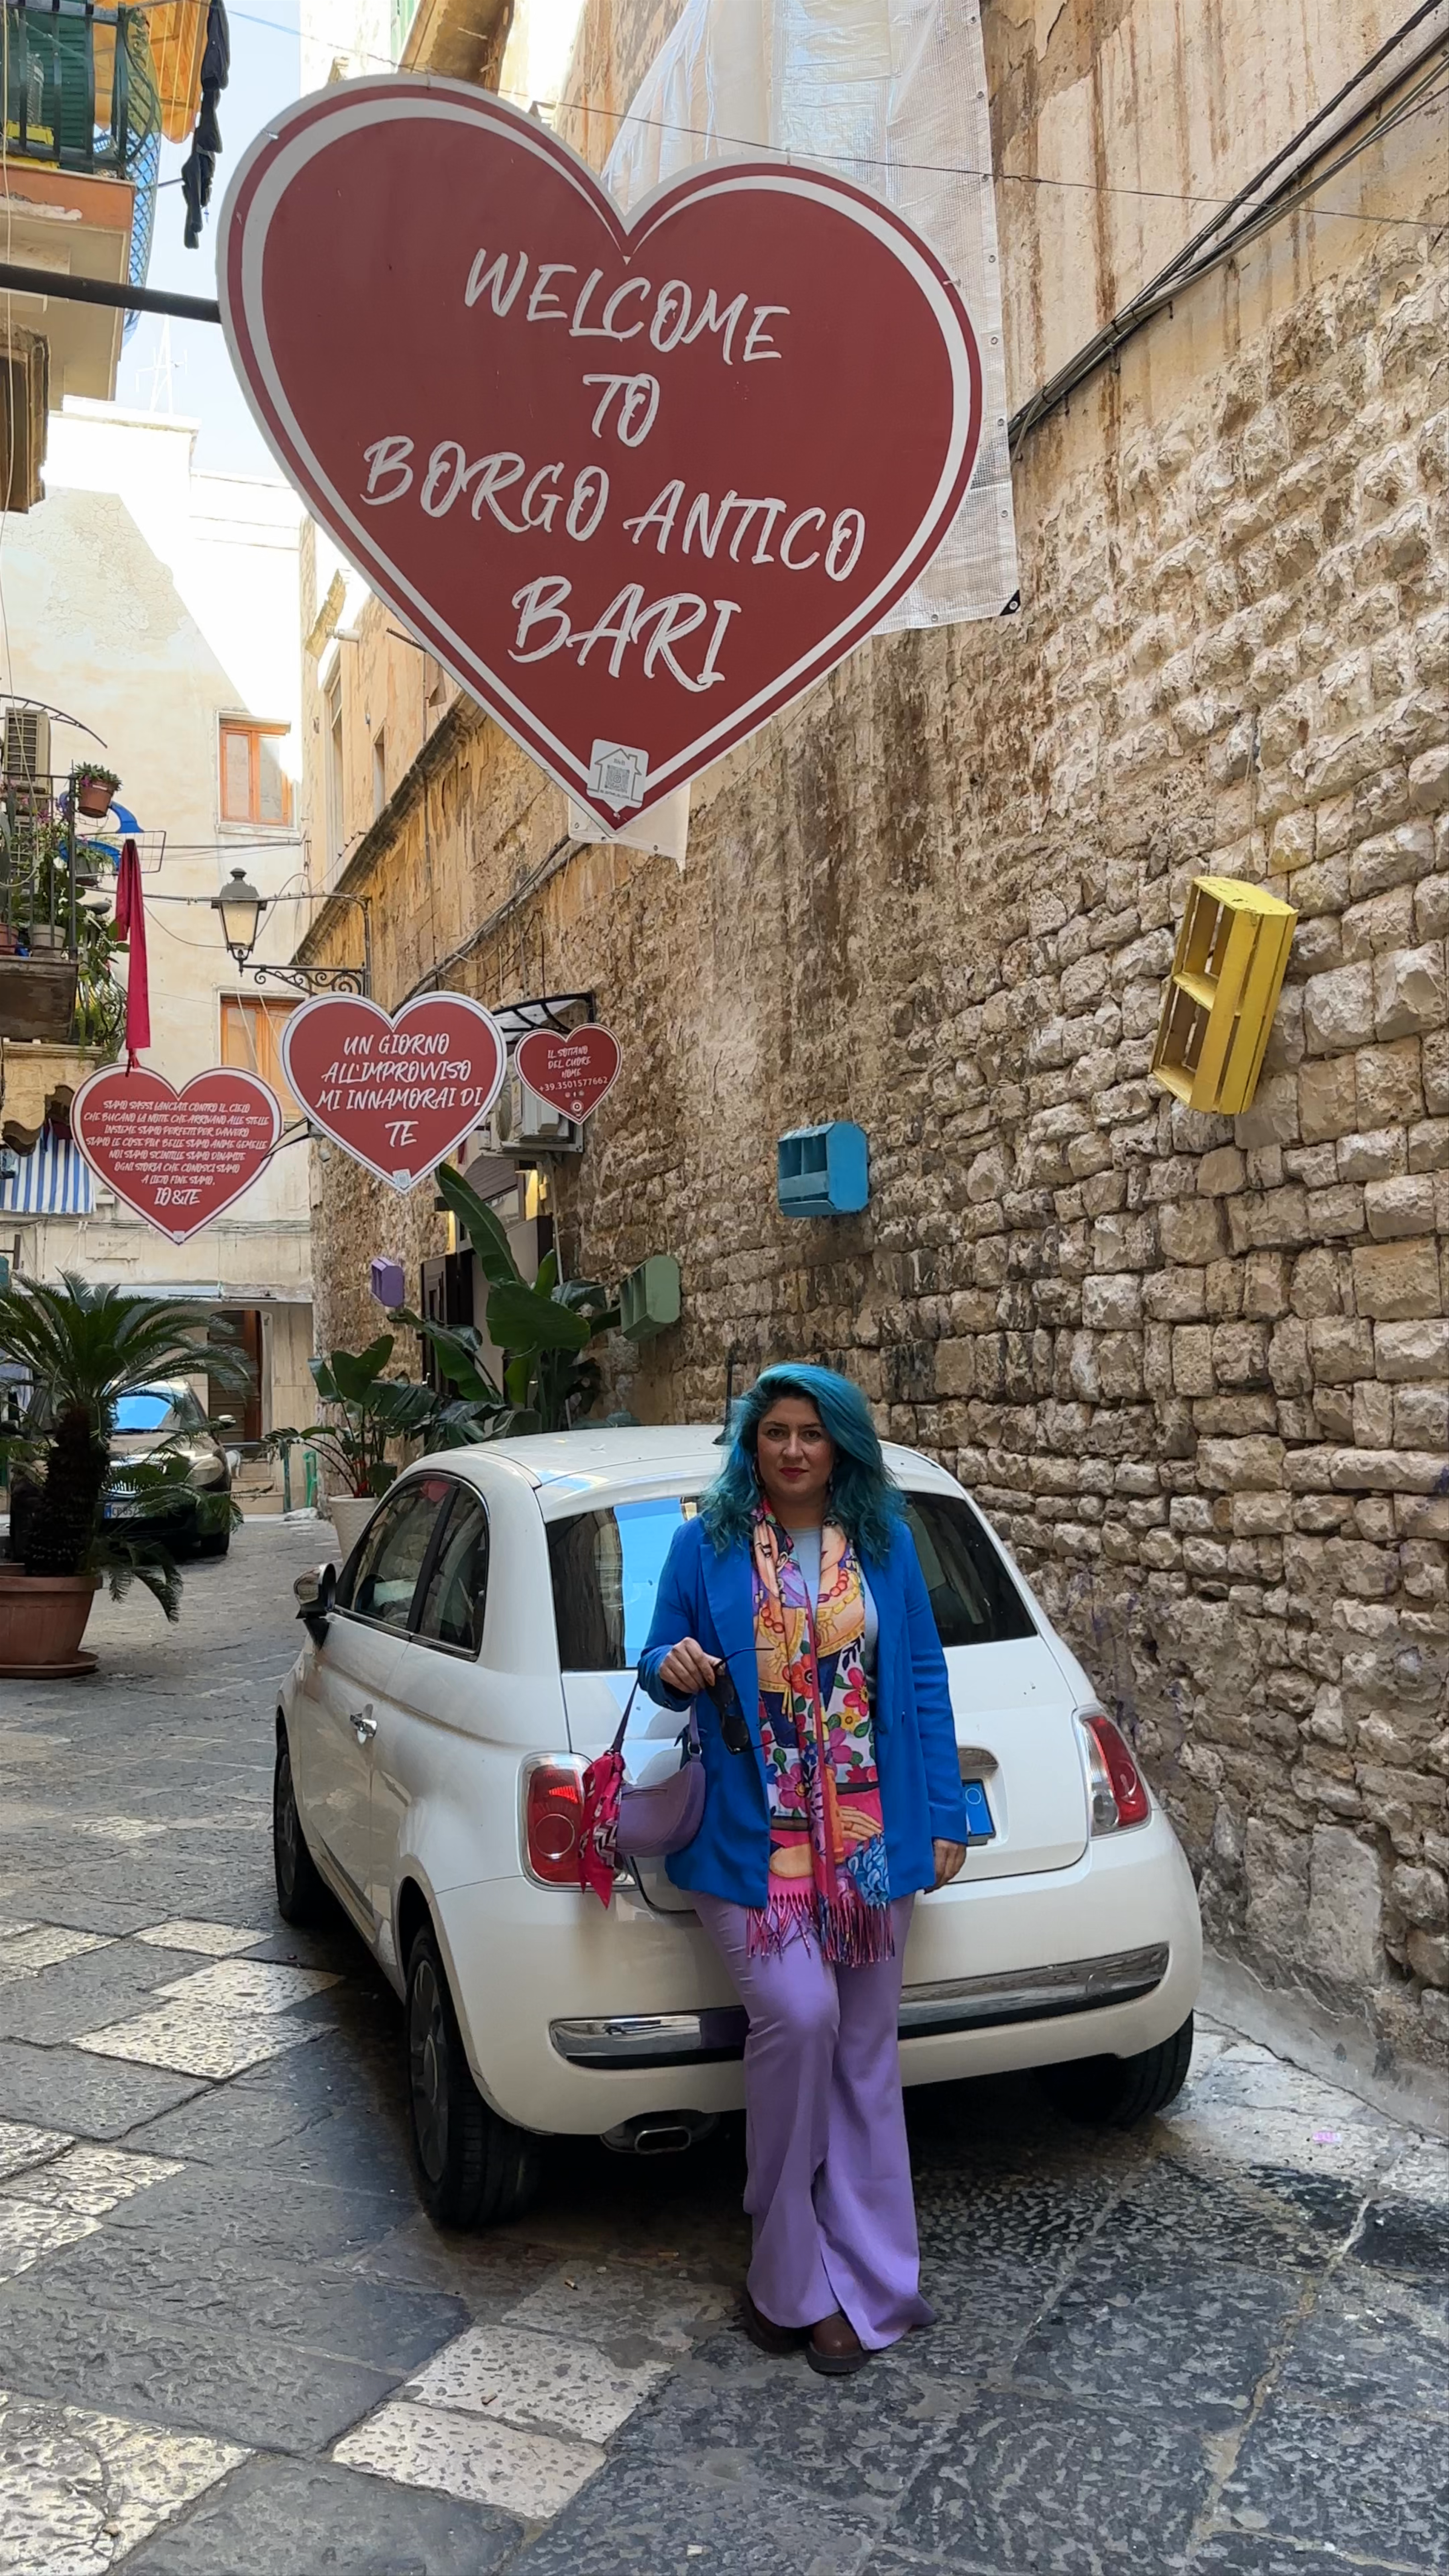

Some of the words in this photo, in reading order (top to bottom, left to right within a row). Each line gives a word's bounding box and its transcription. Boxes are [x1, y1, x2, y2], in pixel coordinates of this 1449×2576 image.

[464, 247, 791, 366] WELCOME
[583, 373, 661, 448] TO
[359, 435, 611, 543] BORGO
[623, 478, 866, 583] ANTICO
[508, 574, 743, 694] BARI
[343, 1035, 374, 1056] UN
[378, 1032, 450, 1056] GIORNO
[548, 1050, 557, 1059] IL
[558, 1046, 588, 1057] SOTTANO
[548, 1060, 564, 1069] DEL
[566, 1057, 591, 1067] CUORE
[320, 1059, 472, 1084] ALL'IMPROVVISO
[561, 1068, 582, 1079] HOME
[540, 1077, 608, 1092] +39.3501577662
[103, 1100, 128, 1110] SIAMO
[129, 1101, 154, 1110] SASSI
[154, 1102, 187, 1111] LANCIATI
[189, 1103, 217, 1112] CONTRO
[219, 1104, 228, 1112] IL
[229, 1104, 251, 1113] CIELO
[315, 1089, 342, 1112] MI
[346, 1087, 455, 1110] INNAMORAI
[460, 1087, 483, 1109] DI
[84, 1112, 101, 1121] CHE
[102, 1113, 136, 1122] BUCANO
[137, 1113, 146, 1122] LA
[148, 1114, 170, 1123] NOTTE
[171, 1114, 188, 1124] CHE
[187, 1115, 226, 1124] ARRIVANO
[227, 1116, 245, 1125] ALLE
[246, 1116, 269, 1126] STELLE
[105, 1124, 137, 1134] INSIEME
[138, 1126, 162, 1135] SIAMO
[163, 1126, 196, 1135] PERFETTI
[196, 1127, 214, 1137] PER
[216, 1127, 249, 1137] DAVVERO
[385, 1120, 419, 1148] TE
[86, 1137, 111, 1146] SIAMO
[112, 1138, 122, 1146] LE
[122, 1138, 145, 1147] COSE
[162, 1139, 184, 1148] BELLE
[186, 1140, 209, 1148] SIAMO
[210, 1140, 235, 1149] ANIME
[236, 1141, 268, 1150] GEMELLE
[109, 1149, 124, 1159] NOI
[124, 1150, 148, 1159] SIAMO
[149, 1151, 185, 1160] SCINTILLE
[186, 1151, 210, 1160] SIAMO
[211, 1152, 246, 1161] DINAMITE
[114, 1163, 134, 1172] OGNI
[135, 1163, 161, 1172] STORIA
[163, 1164, 180, 1172] CHE
[181, 1164, 215, 1173] CONOSCI
[217, 1164, 240, 1173] SIAMO
[141, 1175, 149, 1184] A
[150, 1175, 168, 1184] LIETO
[170, 1176, 189, 1184] FINE
